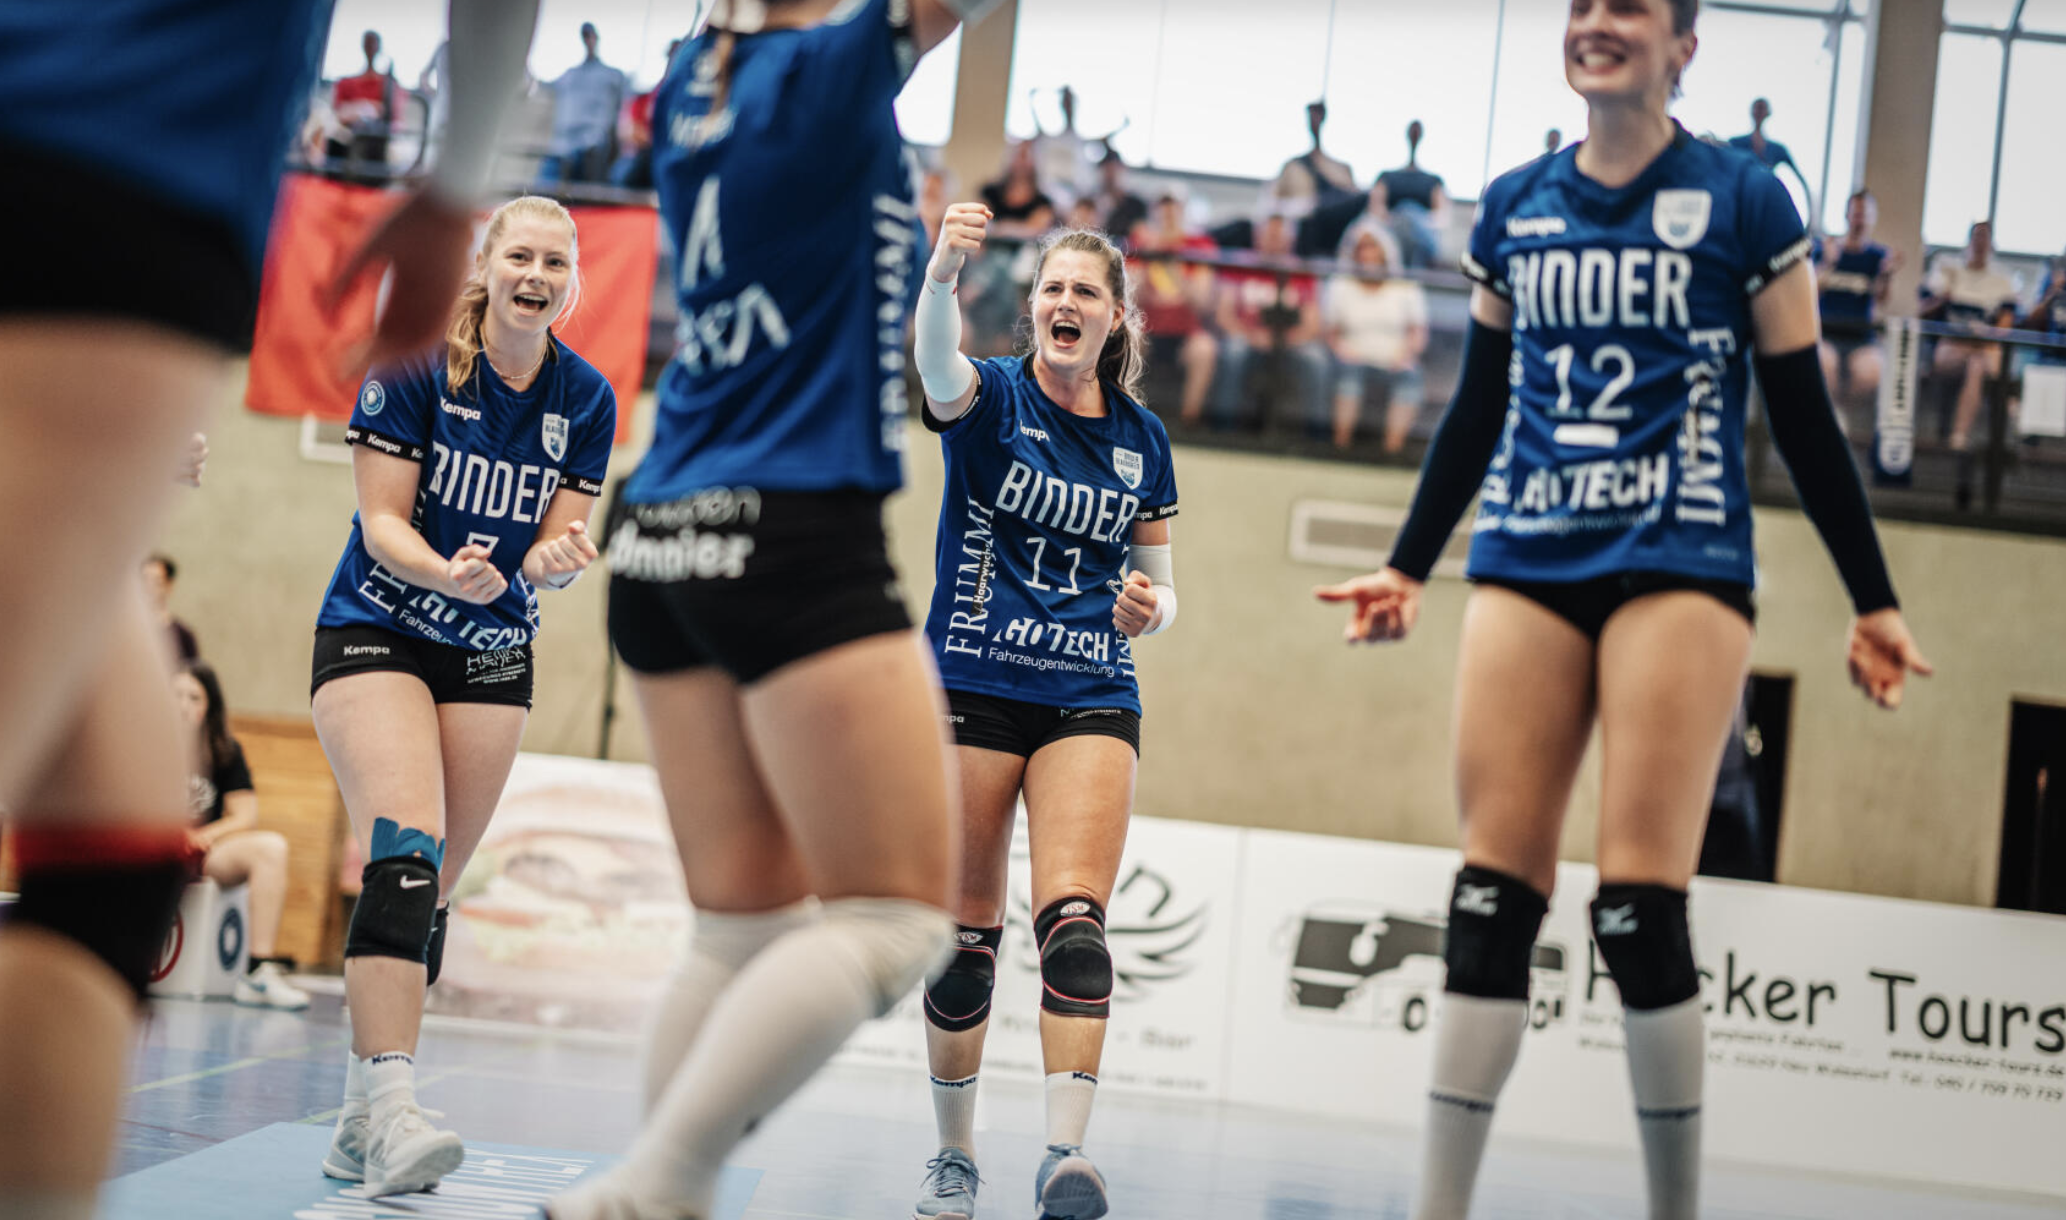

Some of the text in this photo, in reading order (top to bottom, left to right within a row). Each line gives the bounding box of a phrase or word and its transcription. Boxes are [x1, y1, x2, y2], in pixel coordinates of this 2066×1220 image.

[1545, 345, 1635, 420] 12
[367, 433, 401, 454] Kempa
[578, 479, 601, 493] Kemp
[995, 460, 1139, 543] BINDER
[1022, 536, 1084, 596] 11
[343, 645, 390, 656] Kempa
[988, 647, 1115, 678] Fahrzeugentwicklung
[1868, 969, 2066, 1053] Tours
